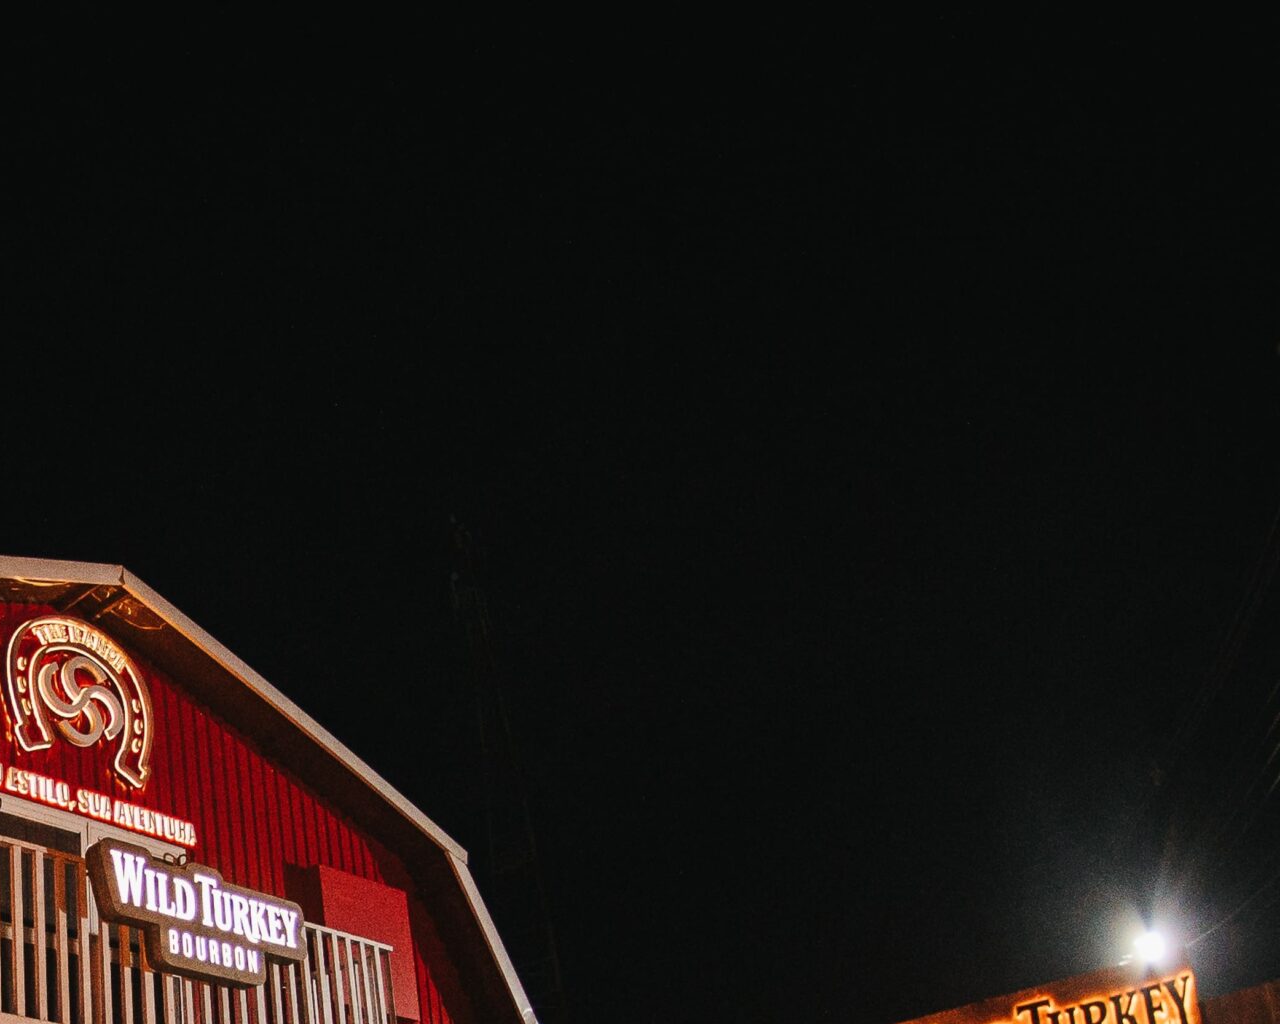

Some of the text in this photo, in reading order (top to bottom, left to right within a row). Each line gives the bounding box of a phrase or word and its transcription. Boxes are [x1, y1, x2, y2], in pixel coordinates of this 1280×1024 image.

[31, 624, 69, 645] THE
[77, 789, 113, 820] SUA
[114, 800, 197, 847] AVENTURA
[109, 849, 297, 949] WILD TURKEY
[168, 929, 260, 974] BOURBON
